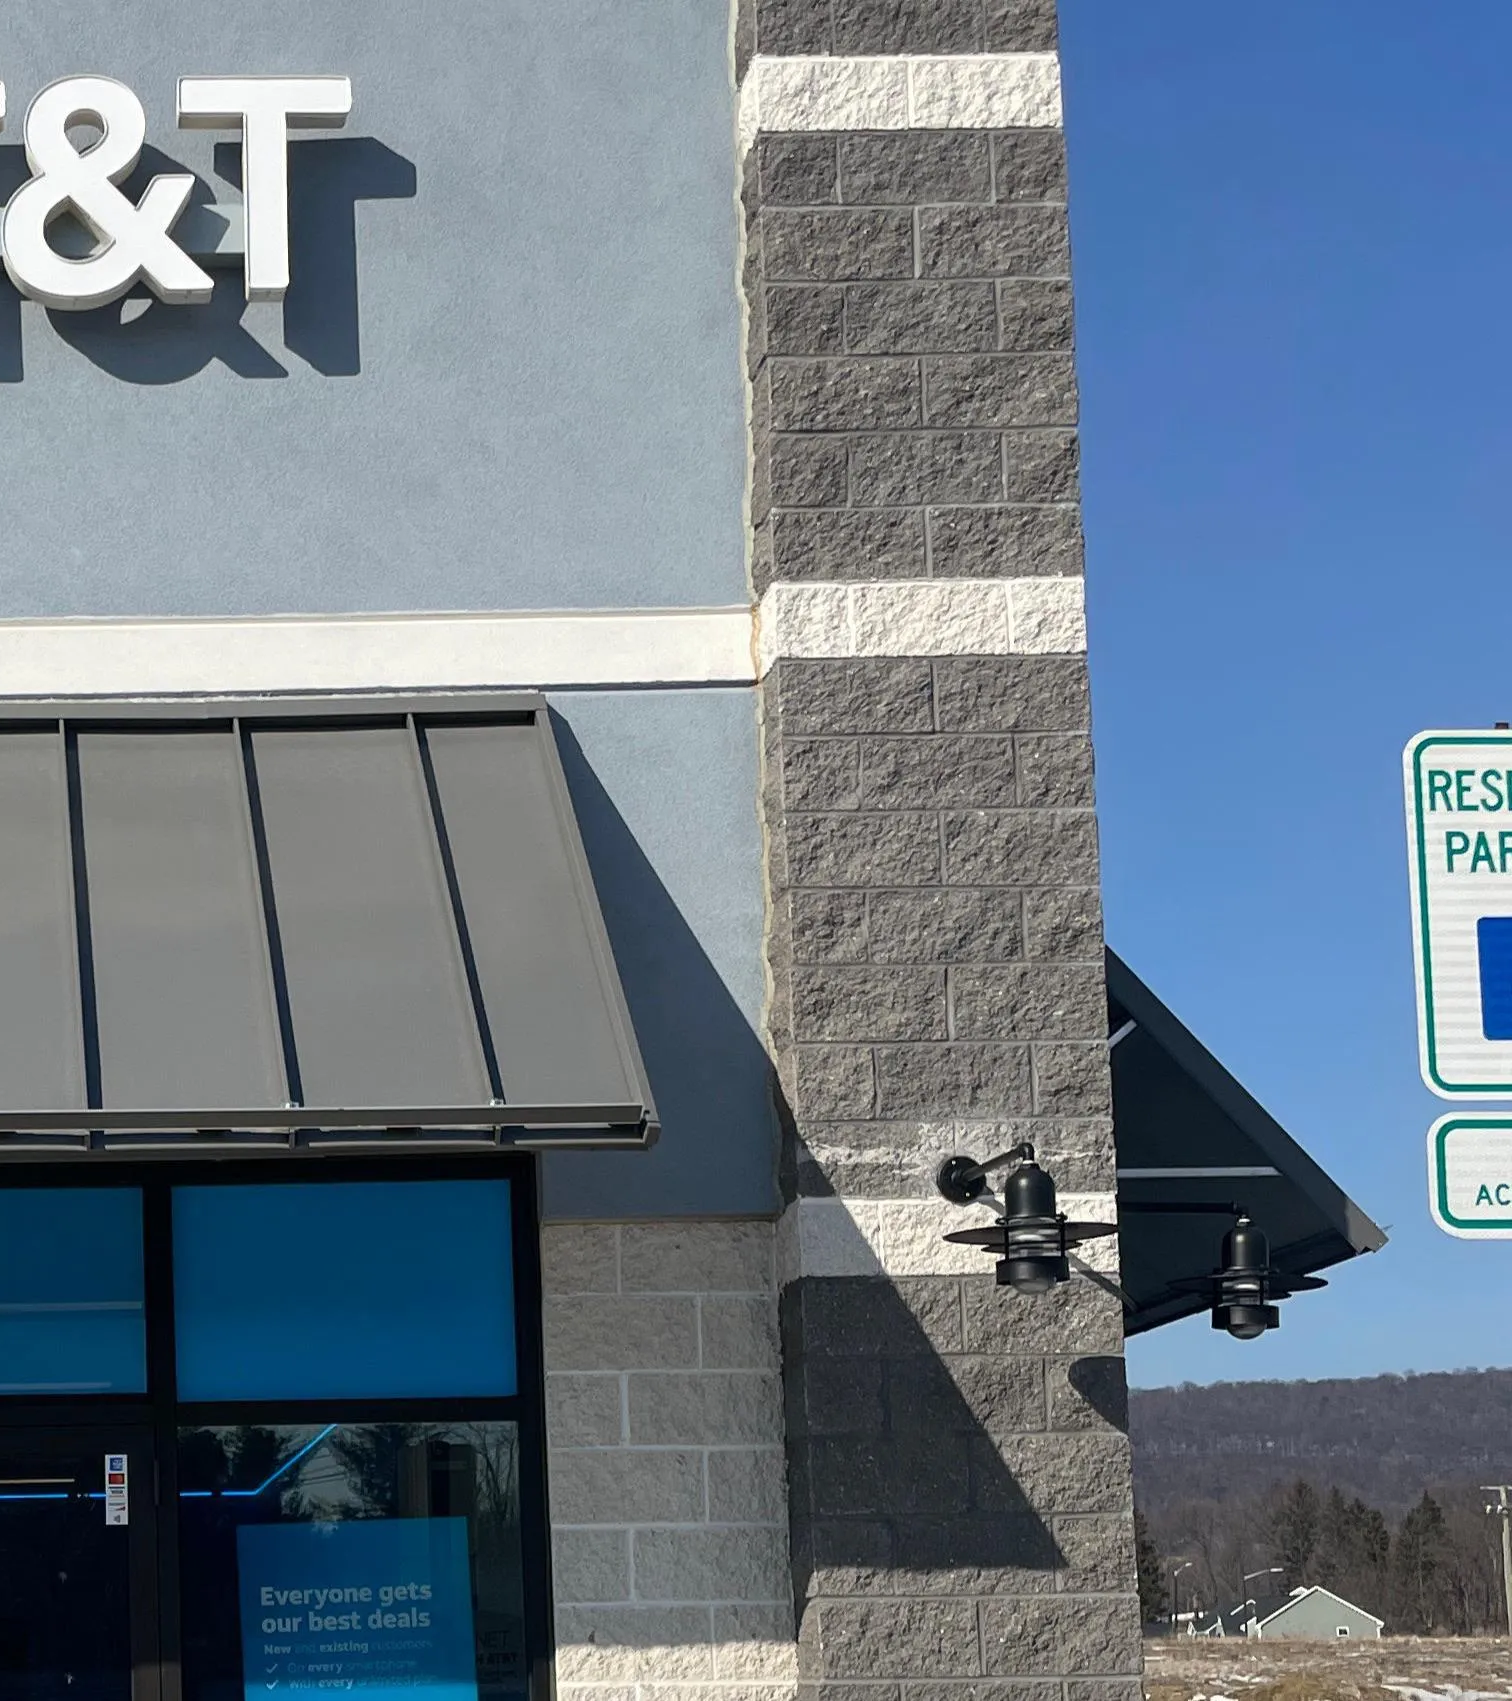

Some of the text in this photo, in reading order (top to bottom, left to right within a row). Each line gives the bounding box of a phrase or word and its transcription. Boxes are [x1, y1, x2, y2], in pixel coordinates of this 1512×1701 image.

[1428, 769, 1512, 812] RES
[260, 1582, 433, 1610] Everyone gets
[261, 1607, 432, 1634] our best deals
[264, 1644, 292, 1655] New
[319, 1641, 369, 1655] existing
[308, 1662, 343, 1674] every
[318, 1678, 354, 1690] every
